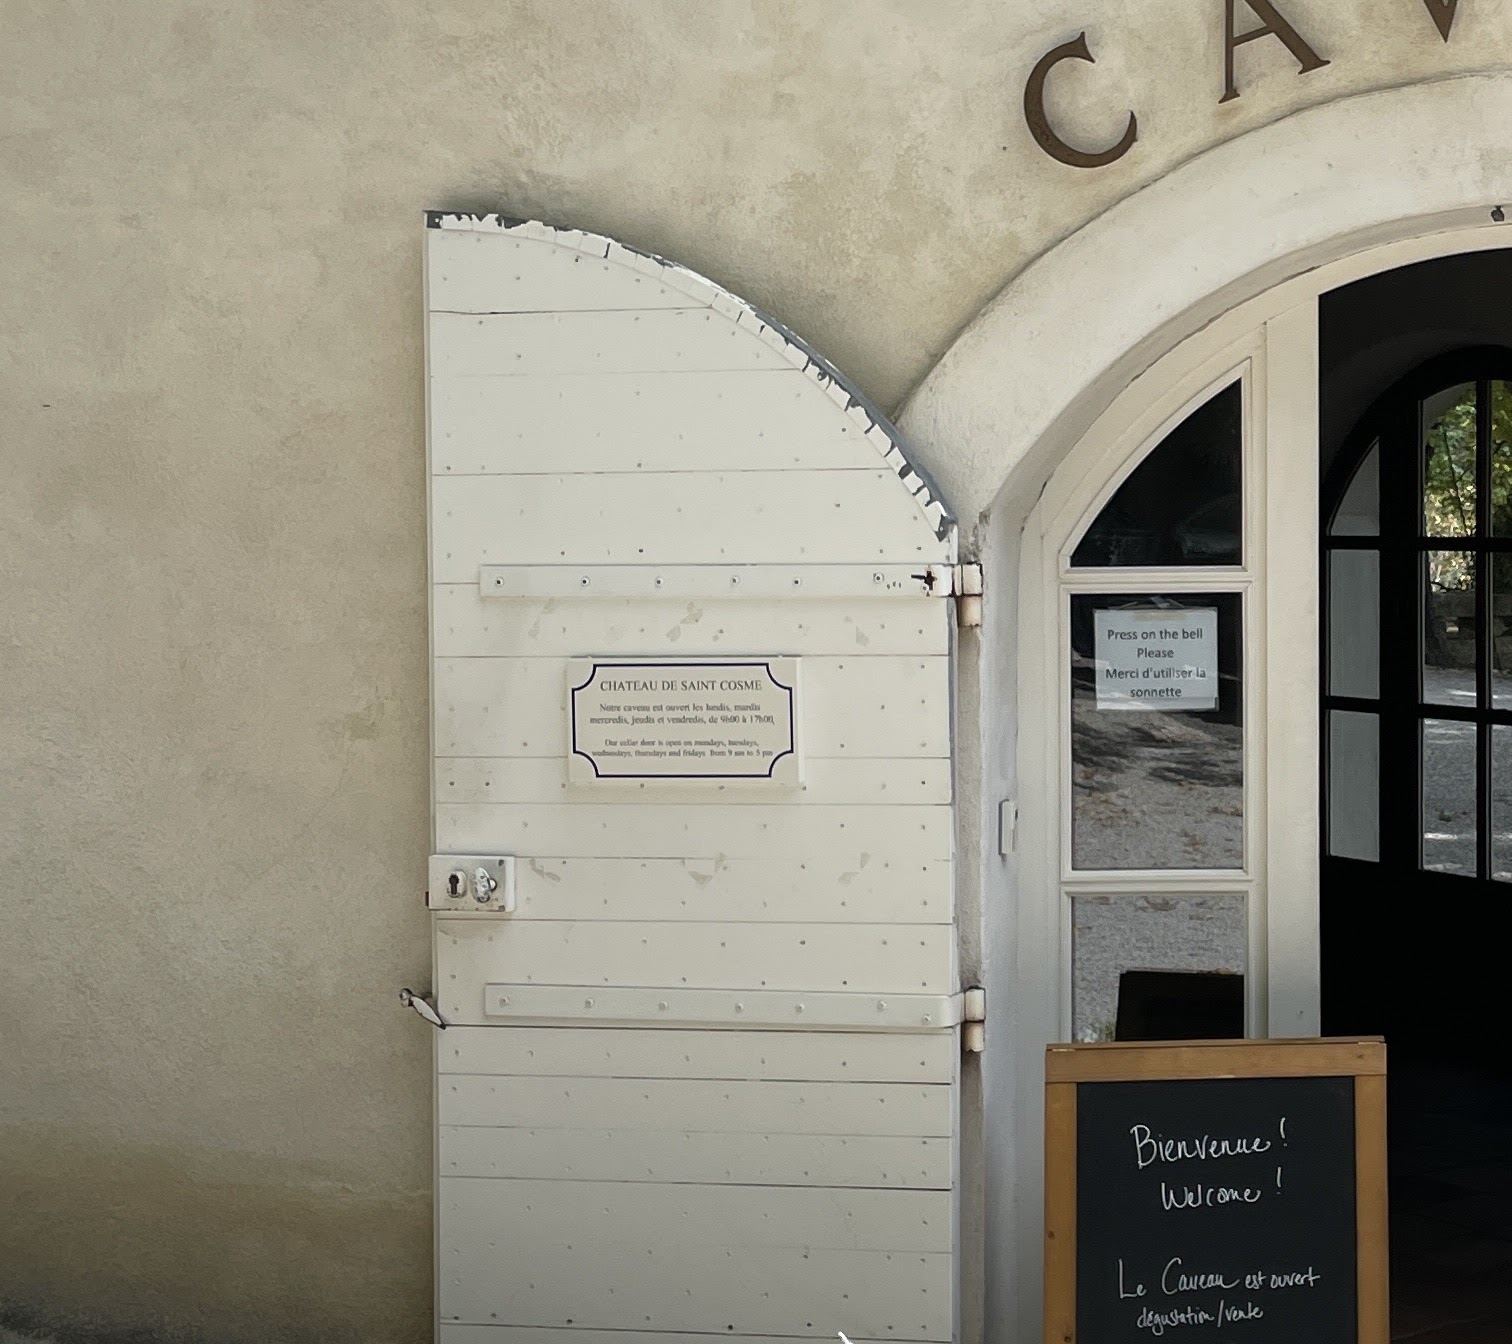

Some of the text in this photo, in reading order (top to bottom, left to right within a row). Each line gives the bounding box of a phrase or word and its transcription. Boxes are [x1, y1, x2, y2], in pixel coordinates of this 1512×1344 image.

[1107, 628, 1203, 640] Press on the bell
[1137, 648, 1175, 659] Please
[1105, 667, 1206, 679] Merci d'utiliser la
[600, 680, 763, 692] CHATEAU DE SAINT COSME
[1130, 687, 1182, 698] sonnette
[600, 703, 621, 712] Notre
[652, 704, 663, 712] est
[665, 704, 690, 712] ouvert
[692, 703, 703, 712] les
[705, 702, 732, 712] lundis,
[589, 716, 630, 724] mercredis,
[631, 716, 655, 726] jeudis
[657, 716, 665, 724] et
[708, 715, 718, 724] de
[605, 739, 617, 747] Our
[640, 738, 656, 746] door
[666, 740, 681, 748] open
[1118, 1256, 1321, 1299] Le Caveau est ouvert
